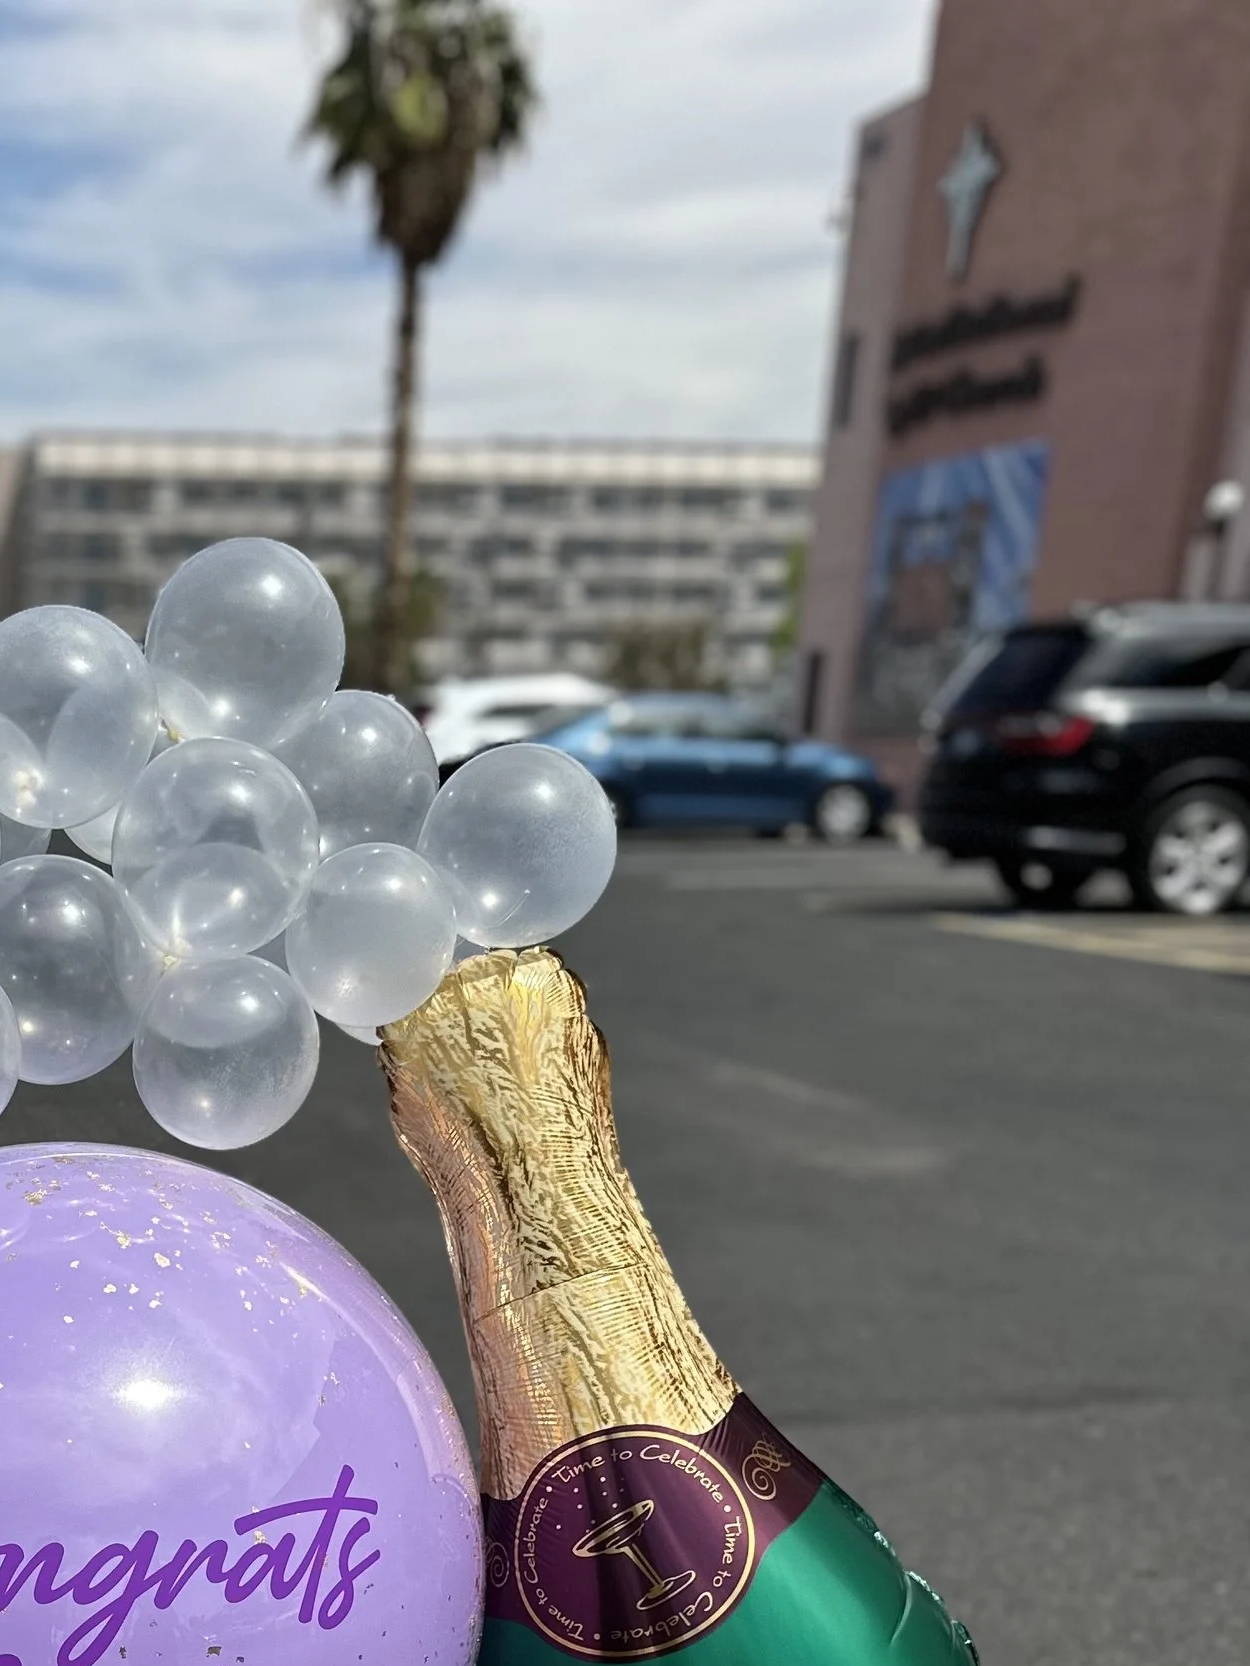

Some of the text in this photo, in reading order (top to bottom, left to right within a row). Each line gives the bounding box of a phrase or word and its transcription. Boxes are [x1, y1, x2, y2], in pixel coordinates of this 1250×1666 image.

[551, 1444, 724, 1504] Time to Celebrate
[523, 1496, 585, 1642] Time to Celebrate
[610, 1515, 743, 1643] Time to Celebrate
